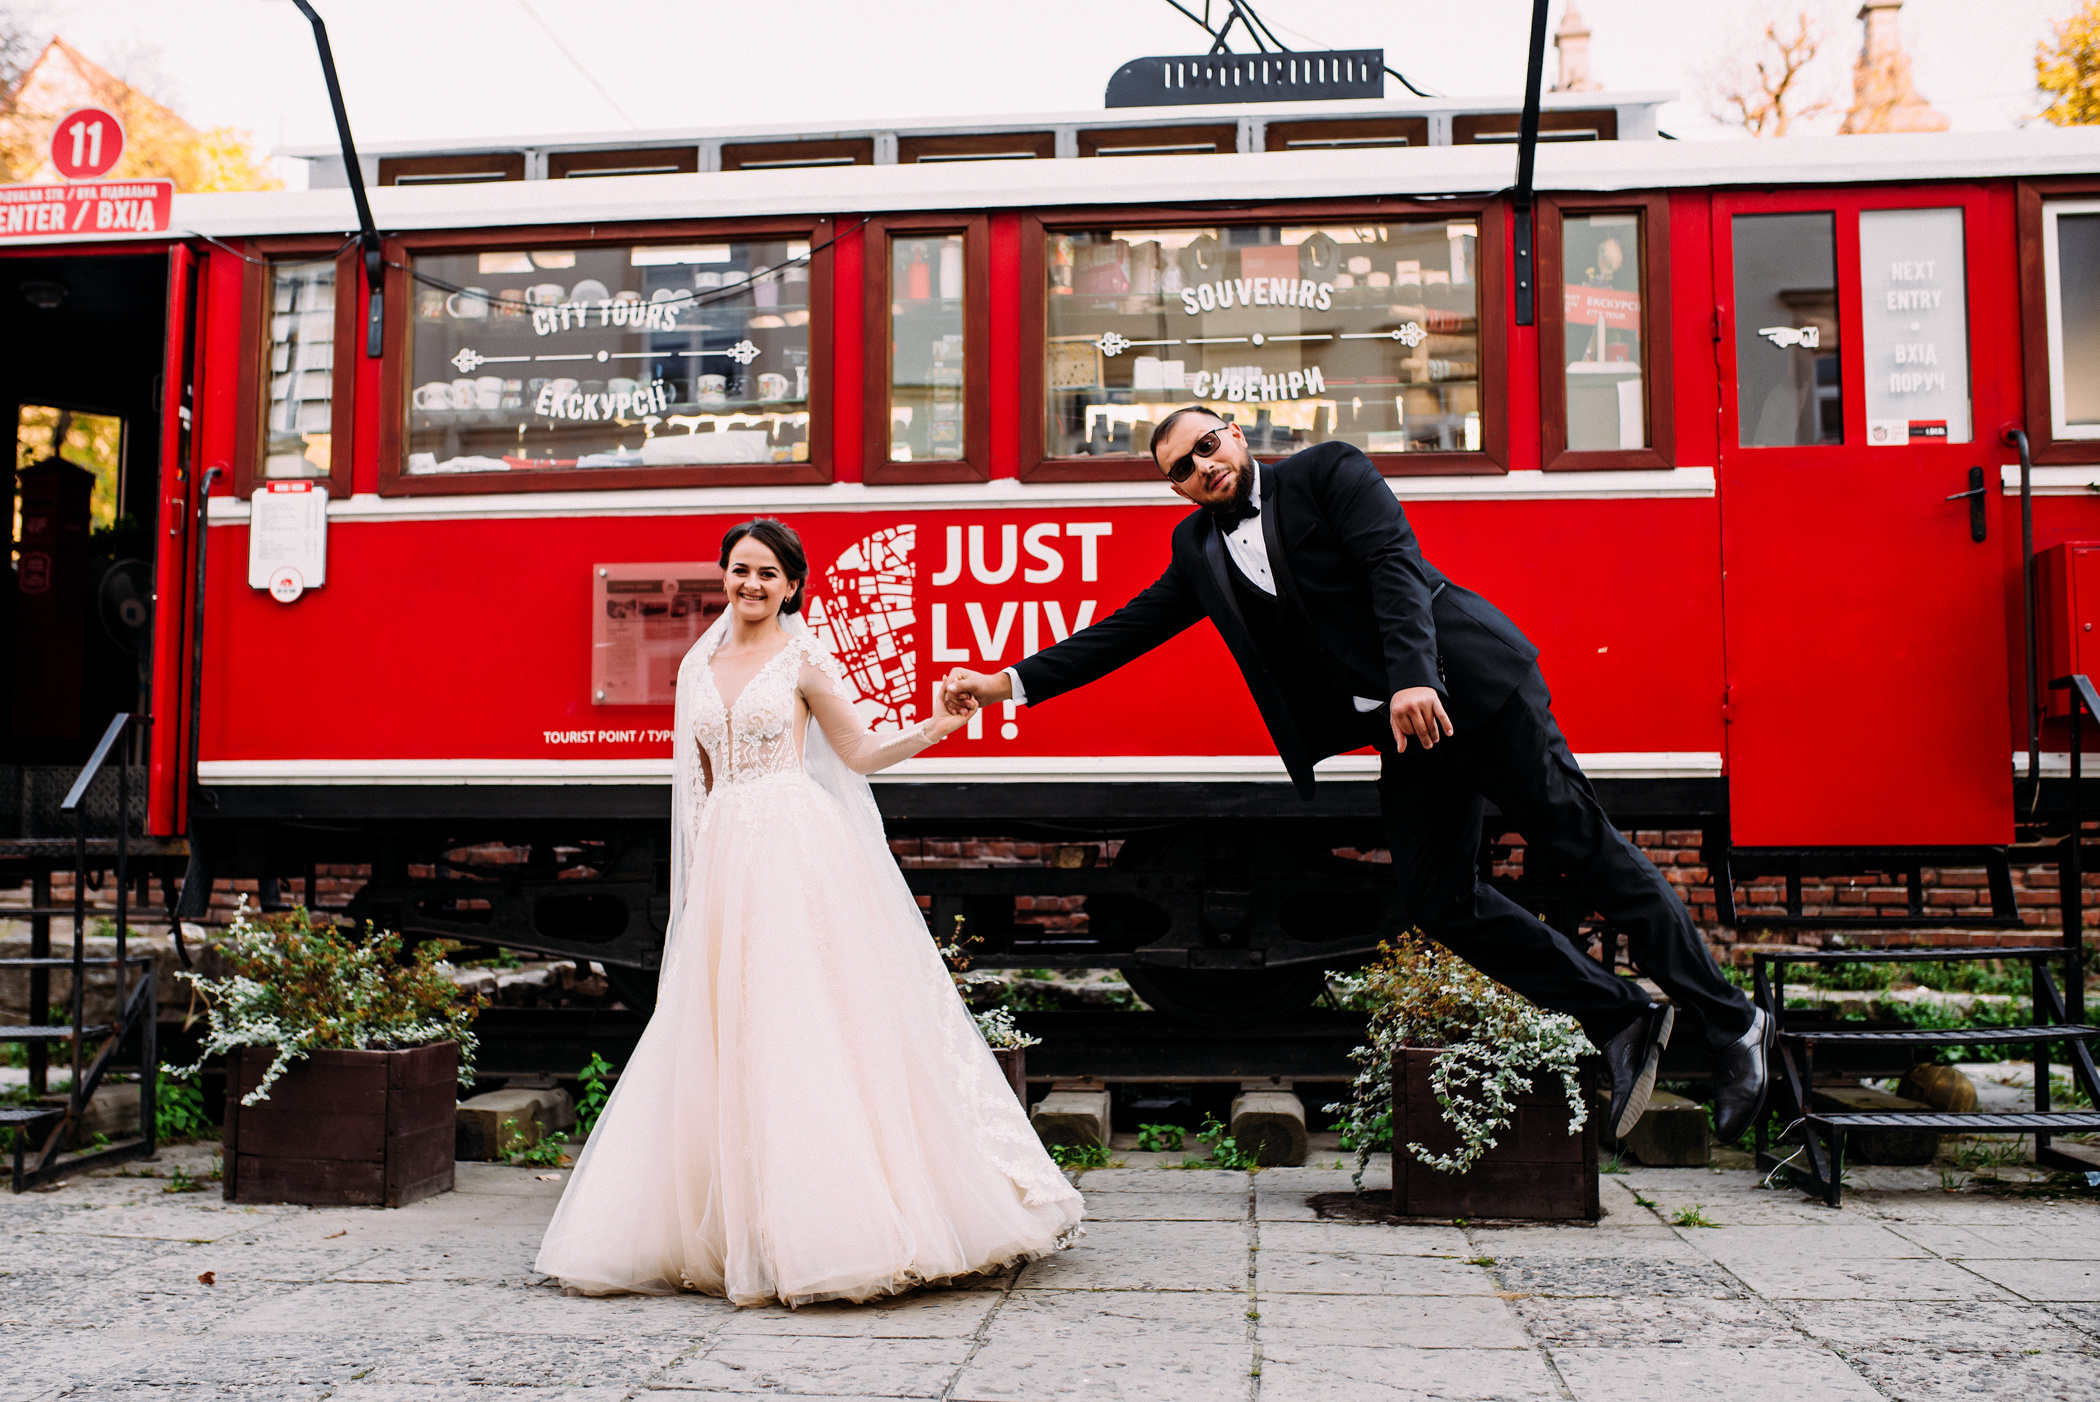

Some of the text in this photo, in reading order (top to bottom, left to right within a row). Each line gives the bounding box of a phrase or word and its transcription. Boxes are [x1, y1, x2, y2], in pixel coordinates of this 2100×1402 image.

[69, 121, 103, 167] 11
[72, 200, 90, 231] /
[96, 199, 155, 232] ВХІД
[1891, 260, 1936, 281] NEXT
[1180, 277, 1334, 316] SOUVENIRS
[1886, 289, 1942, 311] ENTRY
[532, 298, 679, 336] CITY TOURS
[1895, 343, 1938, 366] ВХІД
[535, 379, 668, 420] ЕКСКУРСІЇ
[1192, 365, 1326, 403] СУВЕНІРИ
[1890, 371, 1946, 393] ПОРУЧ
[932, 522, 1112, 586] JUST
[932, 600, 1097, 662] LVIV
[543, 730, 596, 744] TOURIST
[598, 730, 637, 743] POINT
[638, 730, 646, 743] /
